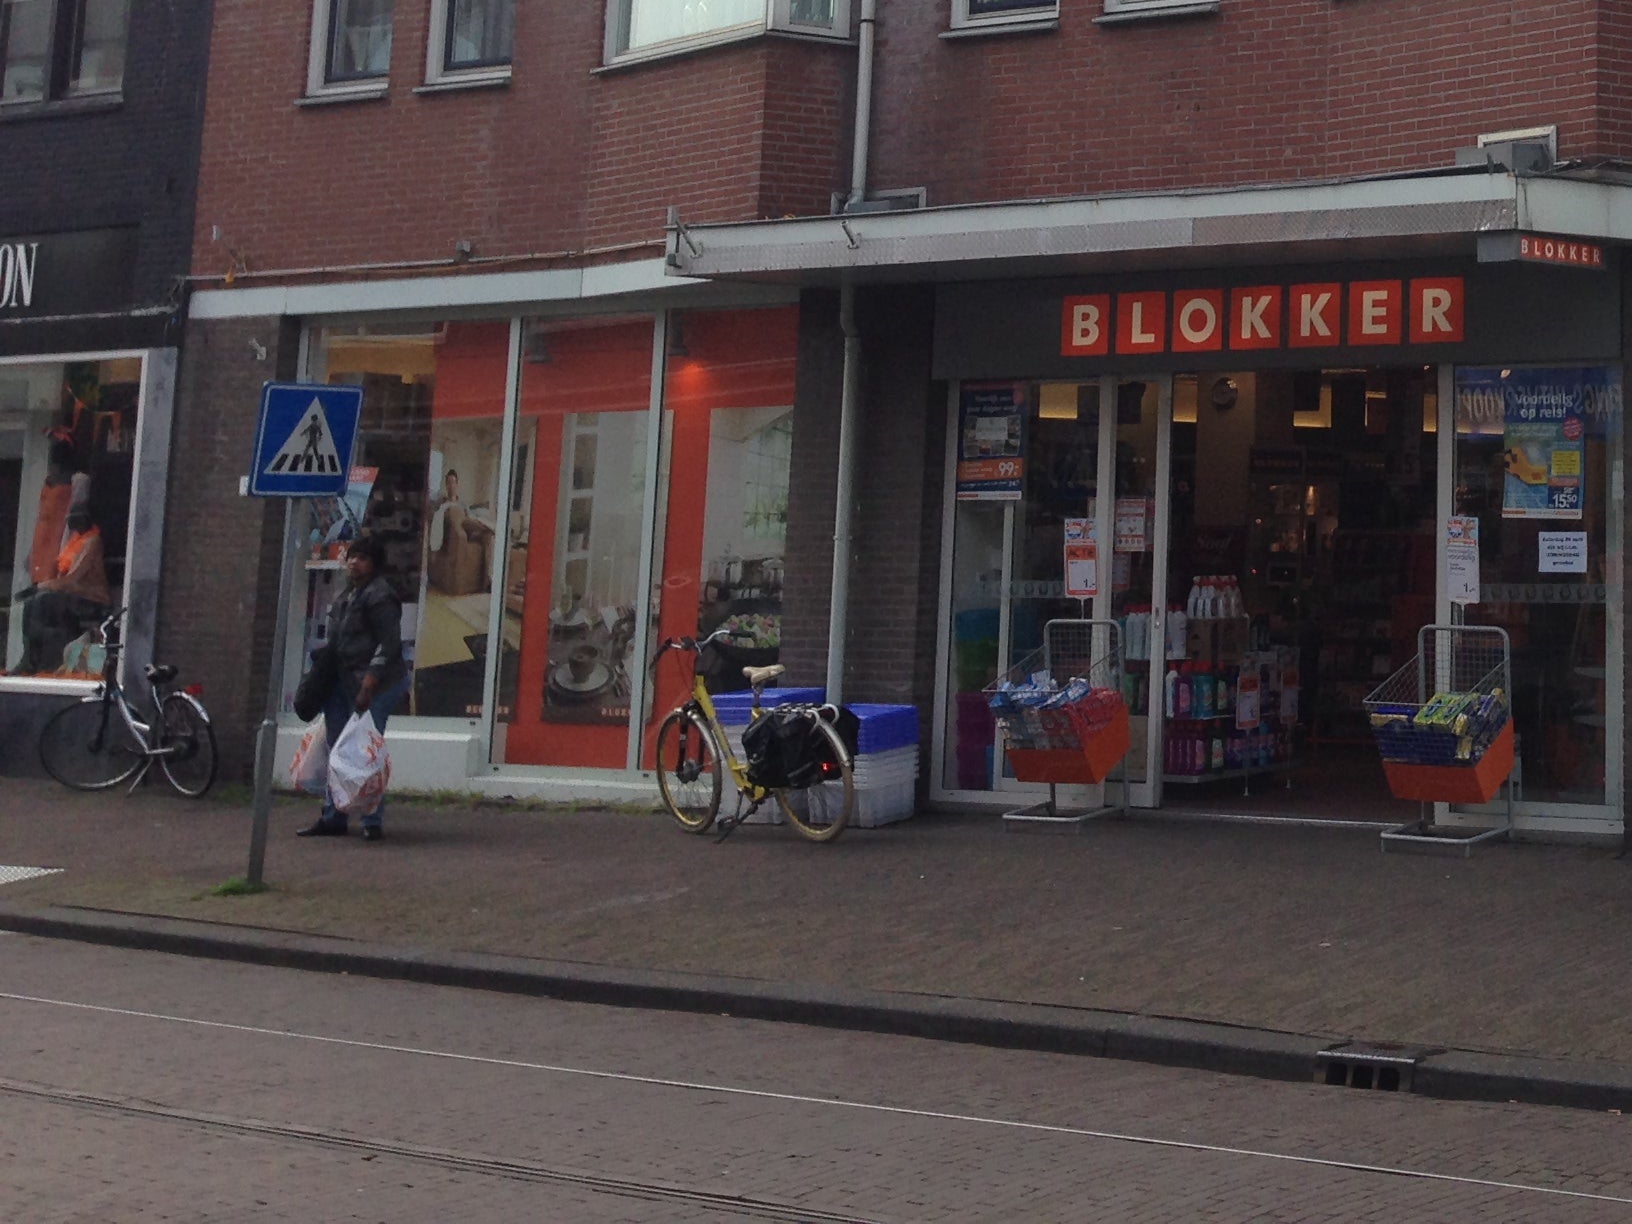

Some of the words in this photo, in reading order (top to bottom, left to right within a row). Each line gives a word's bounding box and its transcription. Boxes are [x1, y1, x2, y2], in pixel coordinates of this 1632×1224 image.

[1521, 238, 1601, 263] BLOKKER
[1071, 287, 1454, 347] BLOKKER
[1520, 407, 1536, 421] op
